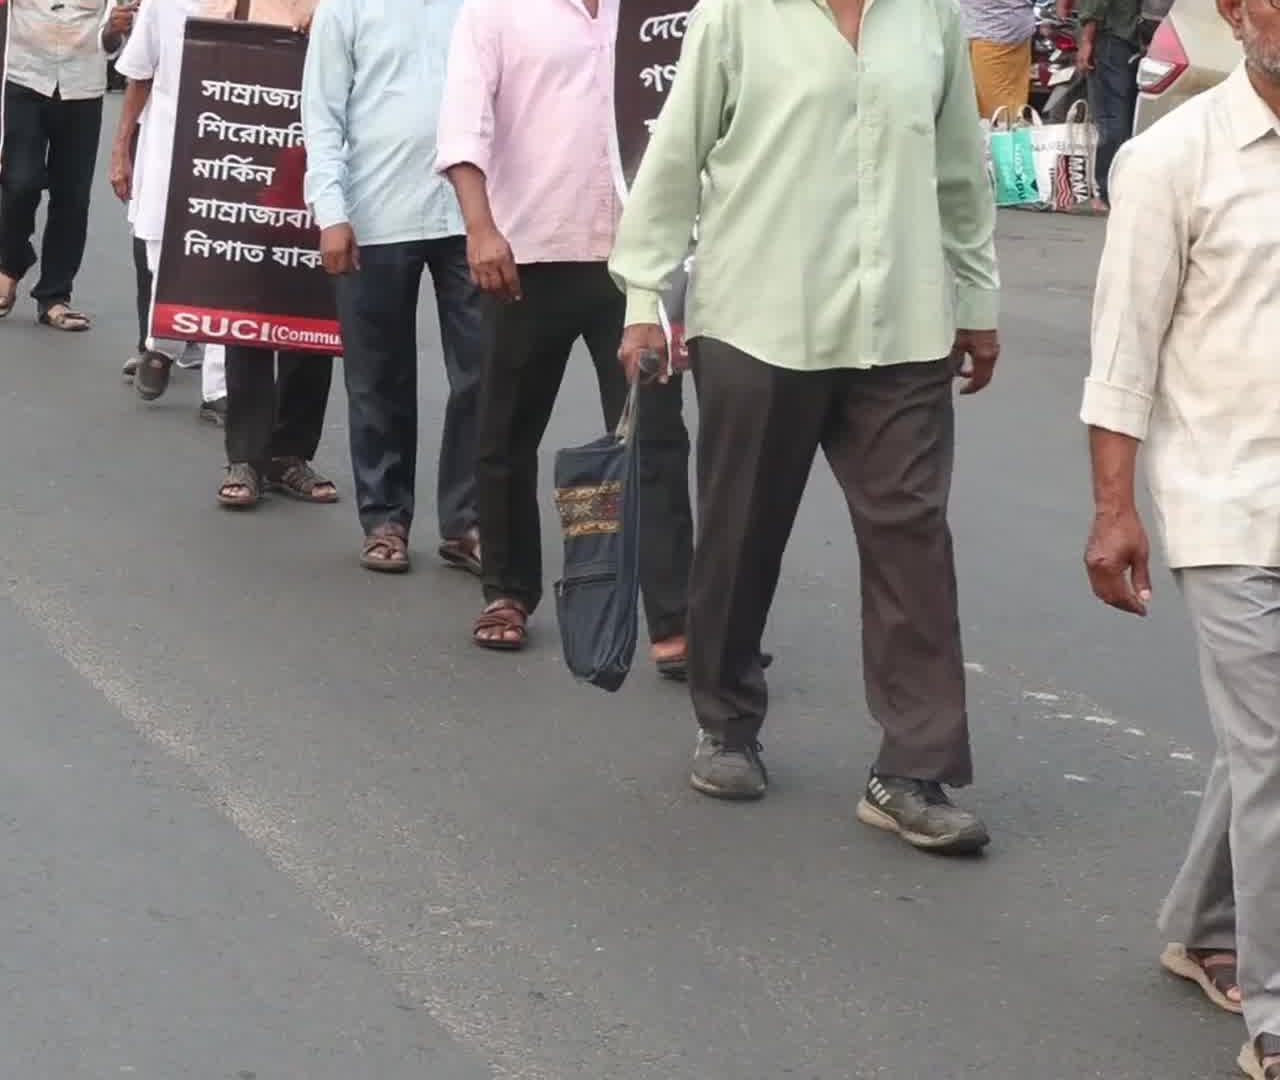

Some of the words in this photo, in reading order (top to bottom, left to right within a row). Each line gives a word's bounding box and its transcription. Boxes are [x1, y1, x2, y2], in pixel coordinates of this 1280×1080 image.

[201, 79, 303, 110] সাম্রাজ্য
[192, 155, 276, 186] মার্কিন
[188, 197, 318, 229] সাম্রাজ্যবা
[184, 229, 266, 263] নিপাত
[172, 312, 270, 342] SUCI
